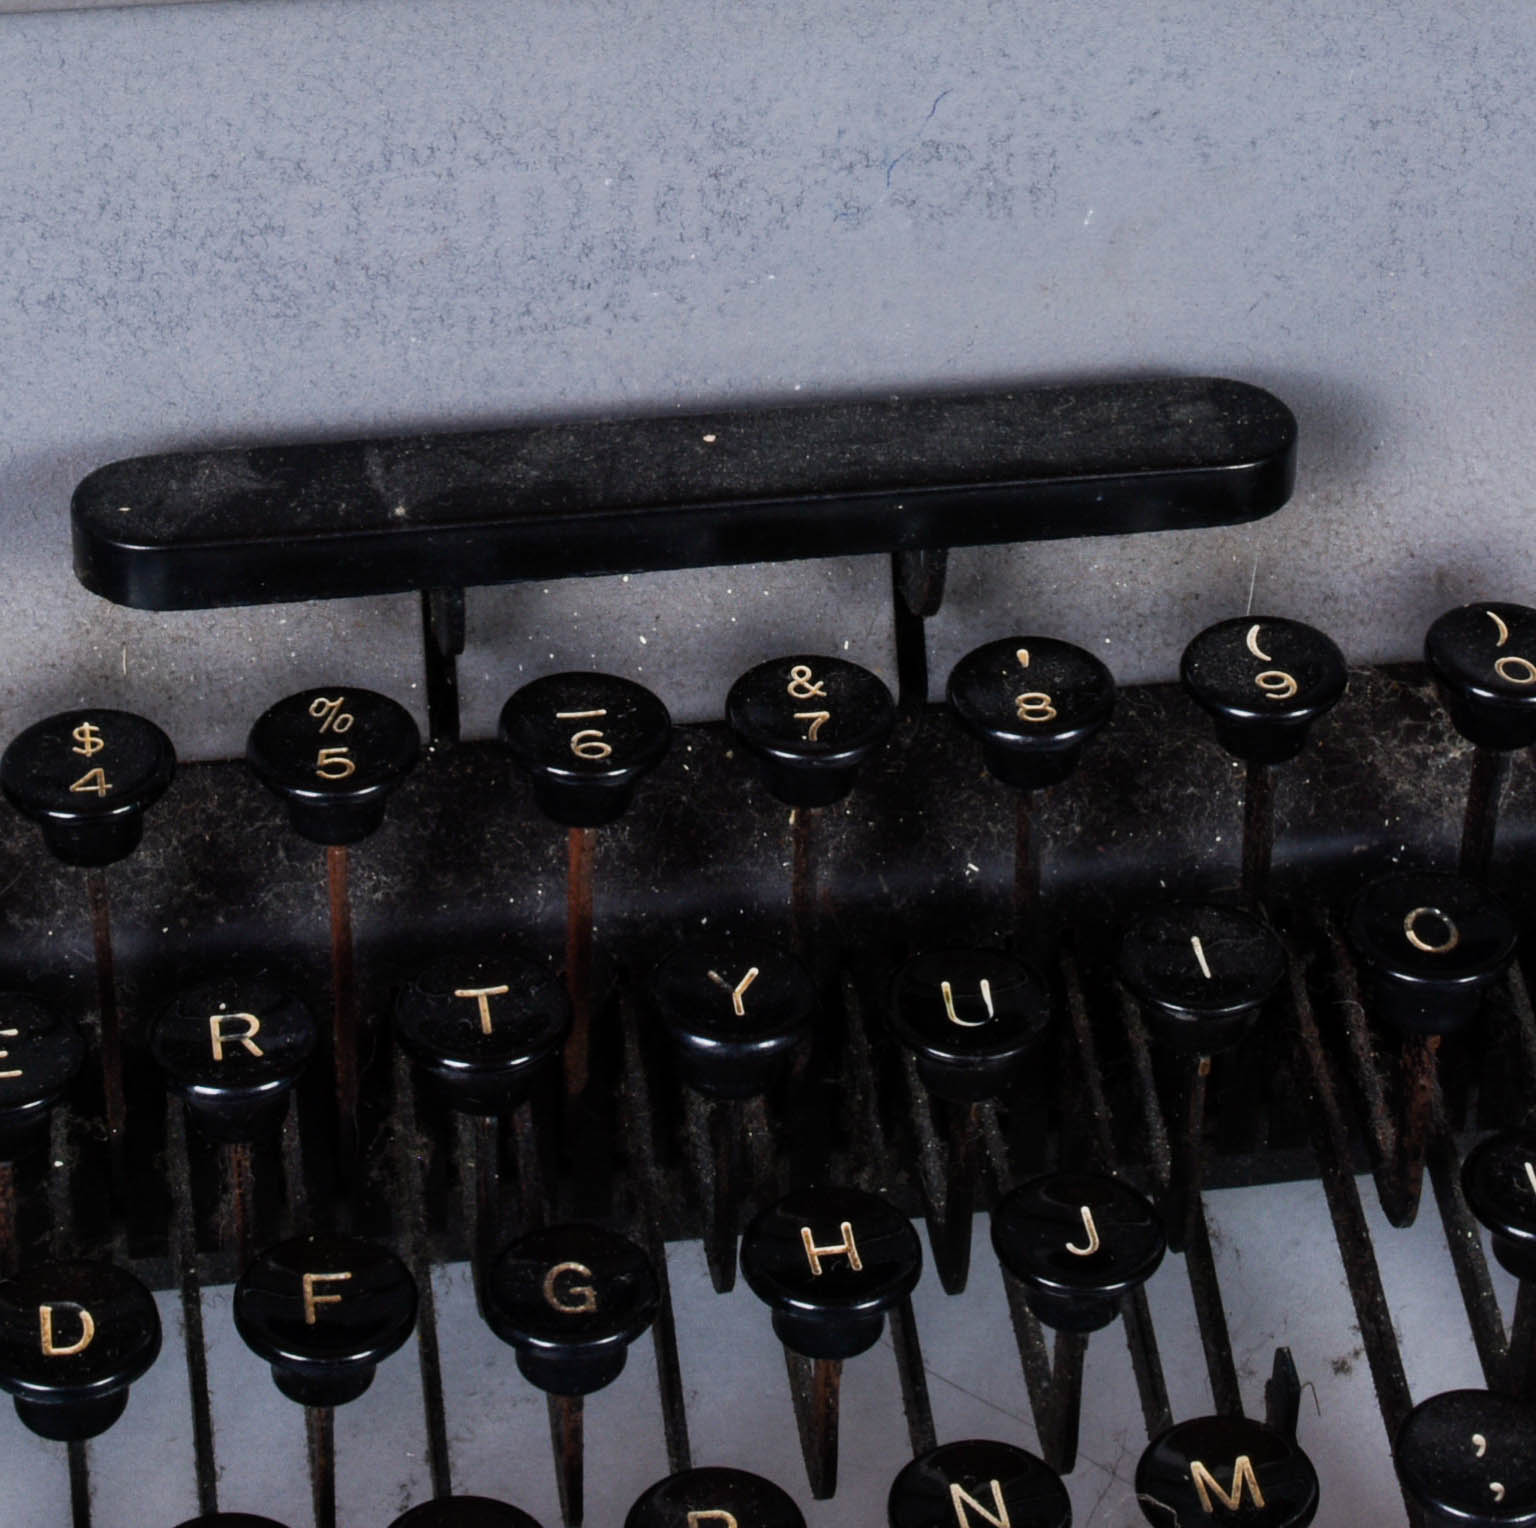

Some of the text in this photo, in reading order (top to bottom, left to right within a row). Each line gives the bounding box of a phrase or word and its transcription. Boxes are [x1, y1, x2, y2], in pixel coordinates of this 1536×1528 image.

[1246, 624, 1272, 662] (
[1486, 610, 1509, 647] )
[787, 664, 827, 699] &
[1254, 670, 1298, 699] 9
[308, 696, 354, 733] %
[794, 710, 831, 742] 7
[1015, 692, 1057, 722] 8
[72, 721, 105, 758] $
[570, 729, 613, 759] 6
[69, 767, 113, 797] 4
[316, 747, 356, 779] 5
[1404, 907, 1459, 953] O
[1190, 935, 1212, 979] I
[453, 984, 509, 1034] T
[708, 966, 760, 1017] Y
[941, 978, 994, 1027] U
[209, 1012, 264, 1061] R
[800, 1221, 863, 1276] H
[1065, 1205, 1100, 1256] J
[302, 1271, 353, 1324] F
[544, 1261, 597, 1313] G
[39, 1305, 95, 1356] D
[949, 1479, 1011, 1528] N
[1189, 1455, 1265, 1512] M
